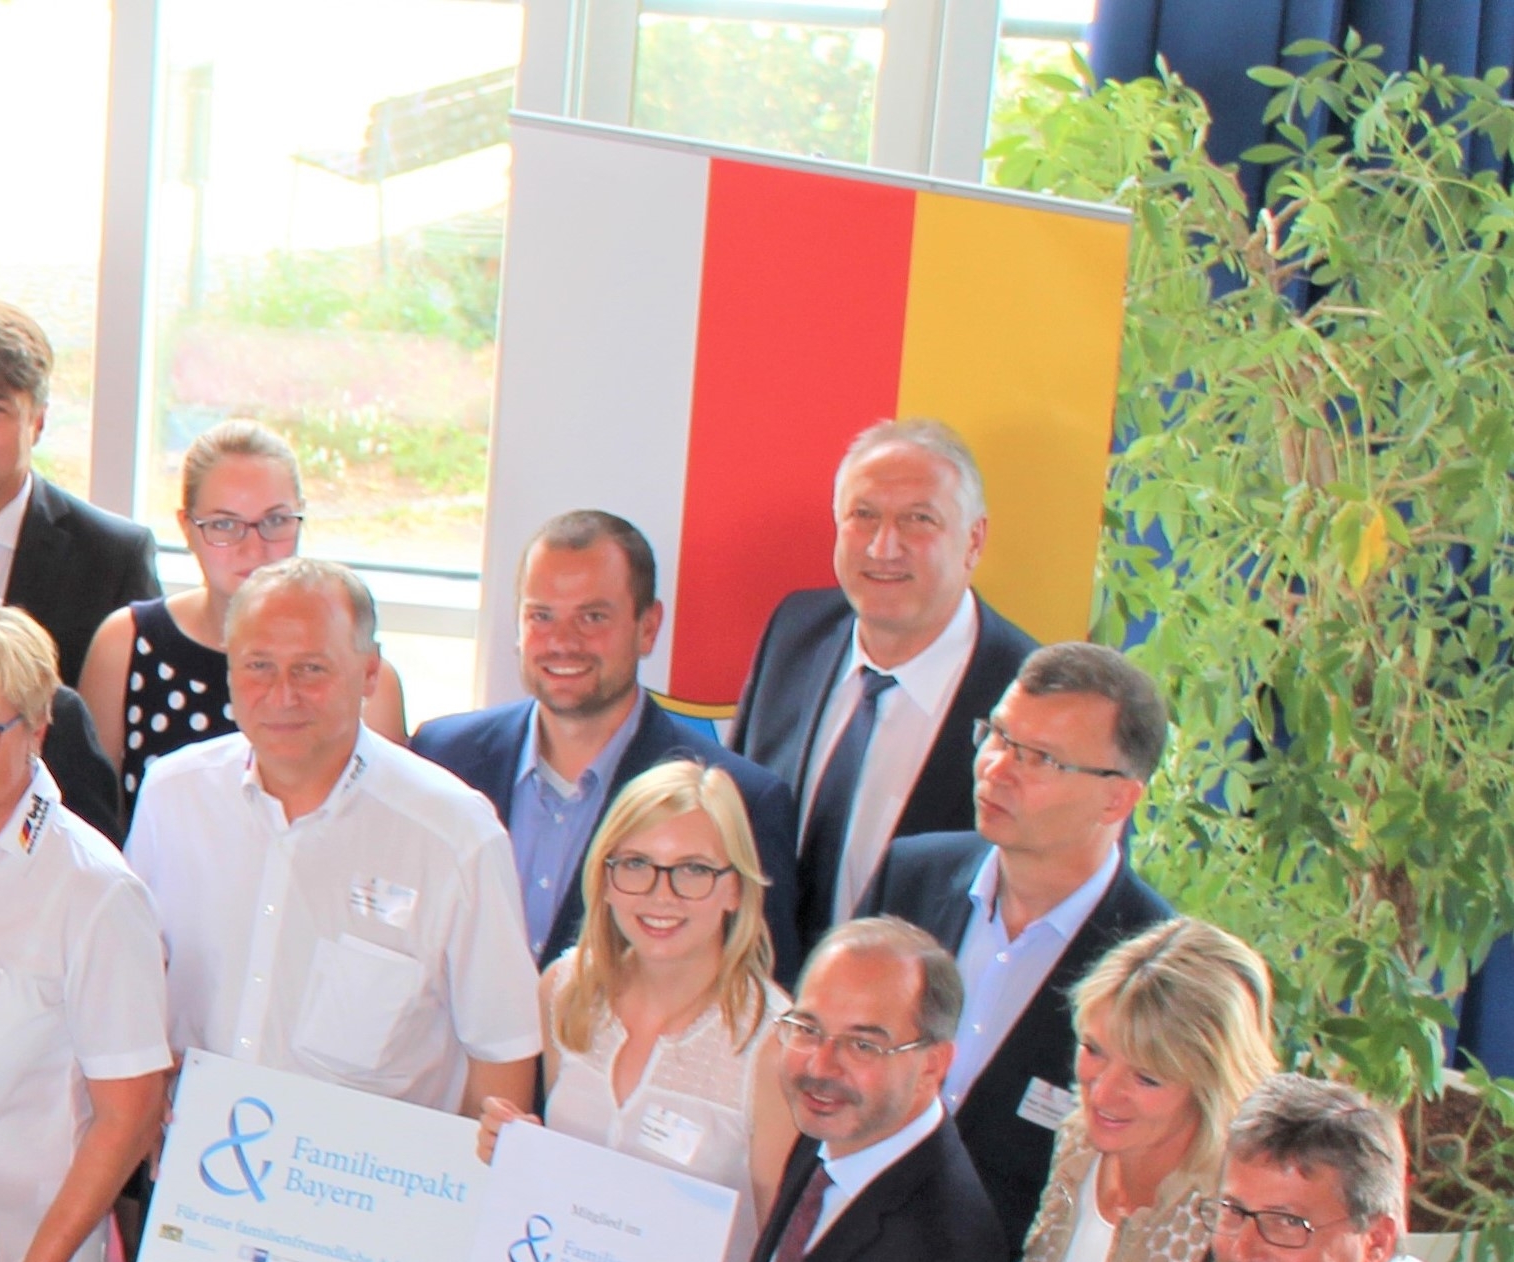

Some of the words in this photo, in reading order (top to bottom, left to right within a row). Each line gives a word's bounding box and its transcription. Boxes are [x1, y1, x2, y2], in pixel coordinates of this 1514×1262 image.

[291, 1135, 467, 1202] Familienpakt
[284, 1166, 375, 1212] Bayern
[175, 1203, 200, 1223] Für
[203, 1212, 232, 1231] eine
[571, 1204, 622, 1232] Mitglied
[624, 1222, 642, 1236] im
